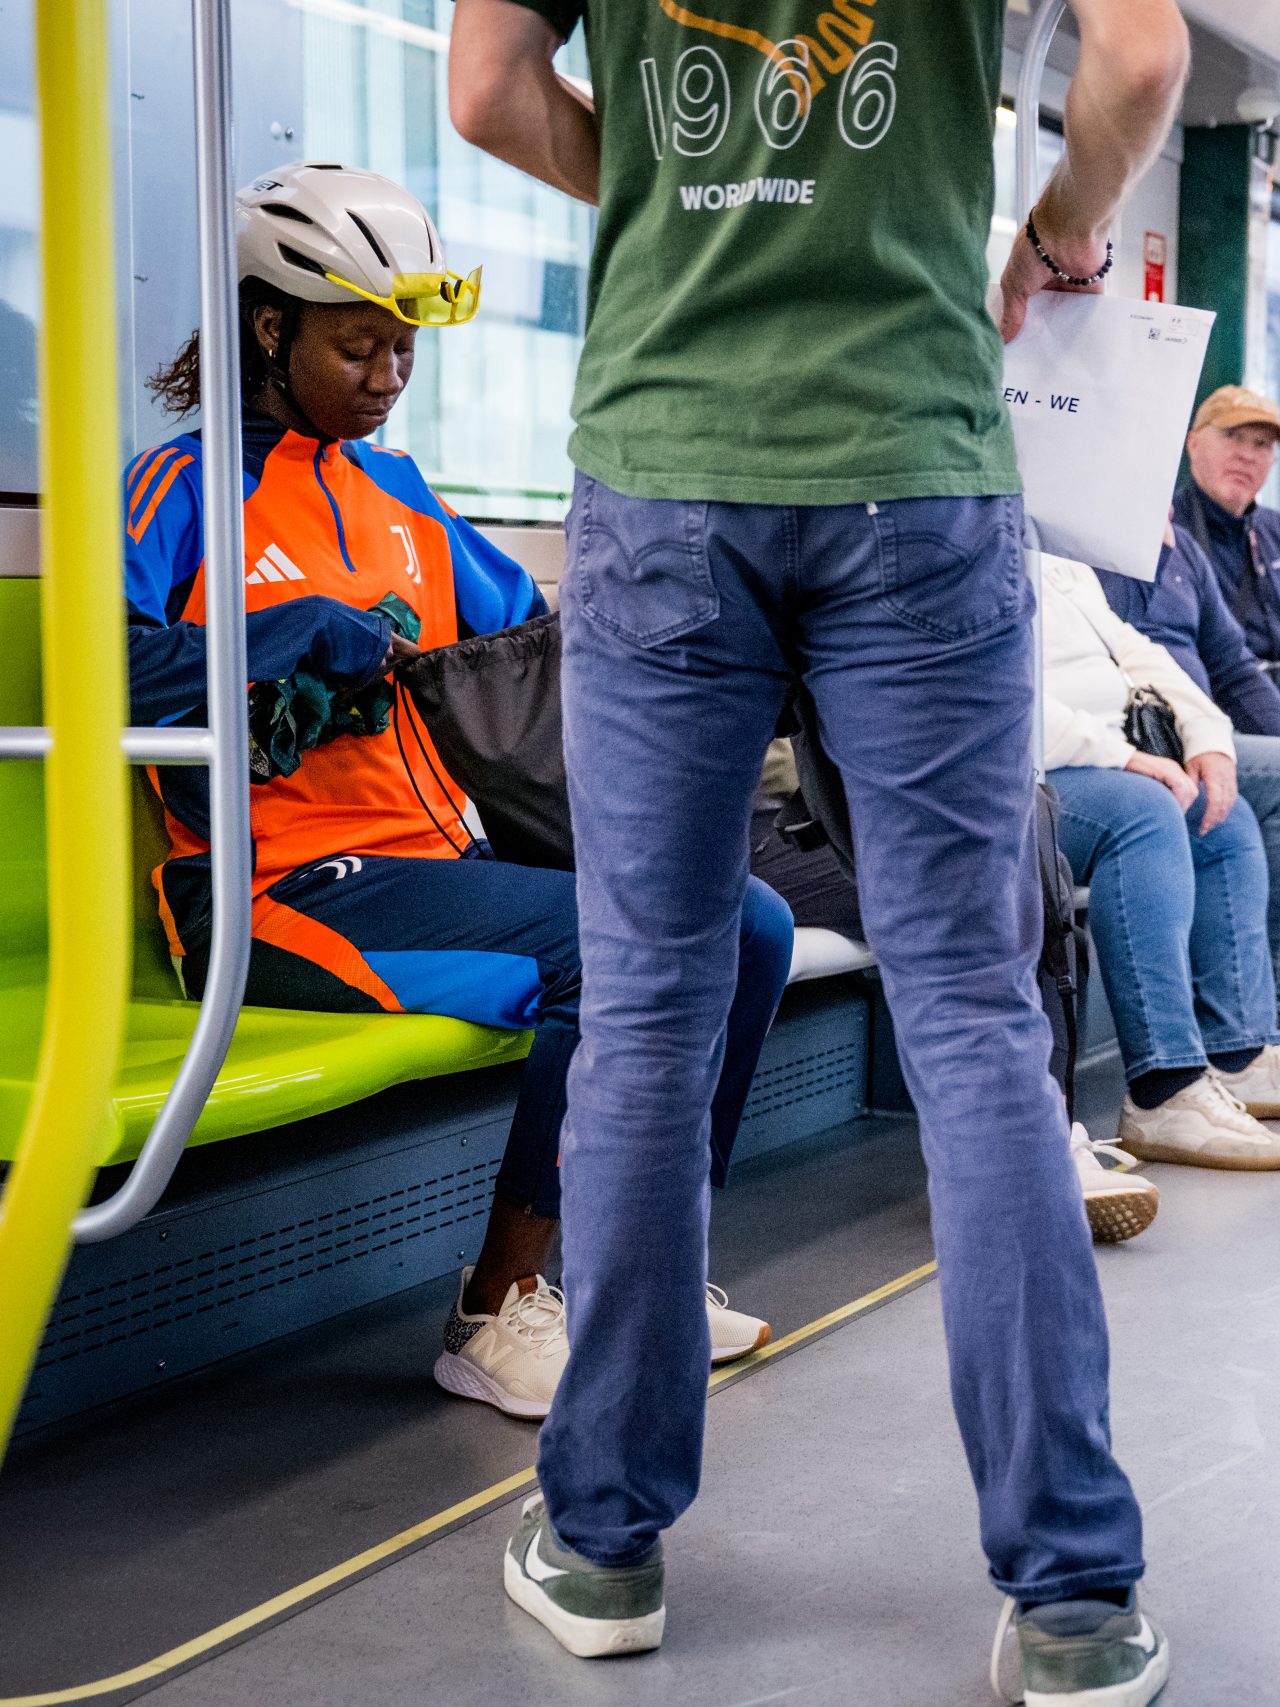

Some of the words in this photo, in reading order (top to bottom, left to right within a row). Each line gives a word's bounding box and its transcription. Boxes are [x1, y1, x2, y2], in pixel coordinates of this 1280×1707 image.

[639, 38, 899, 161] 1966
[253, 180, 284, 192] ET
[1050, 394, 1081, 413] WE
